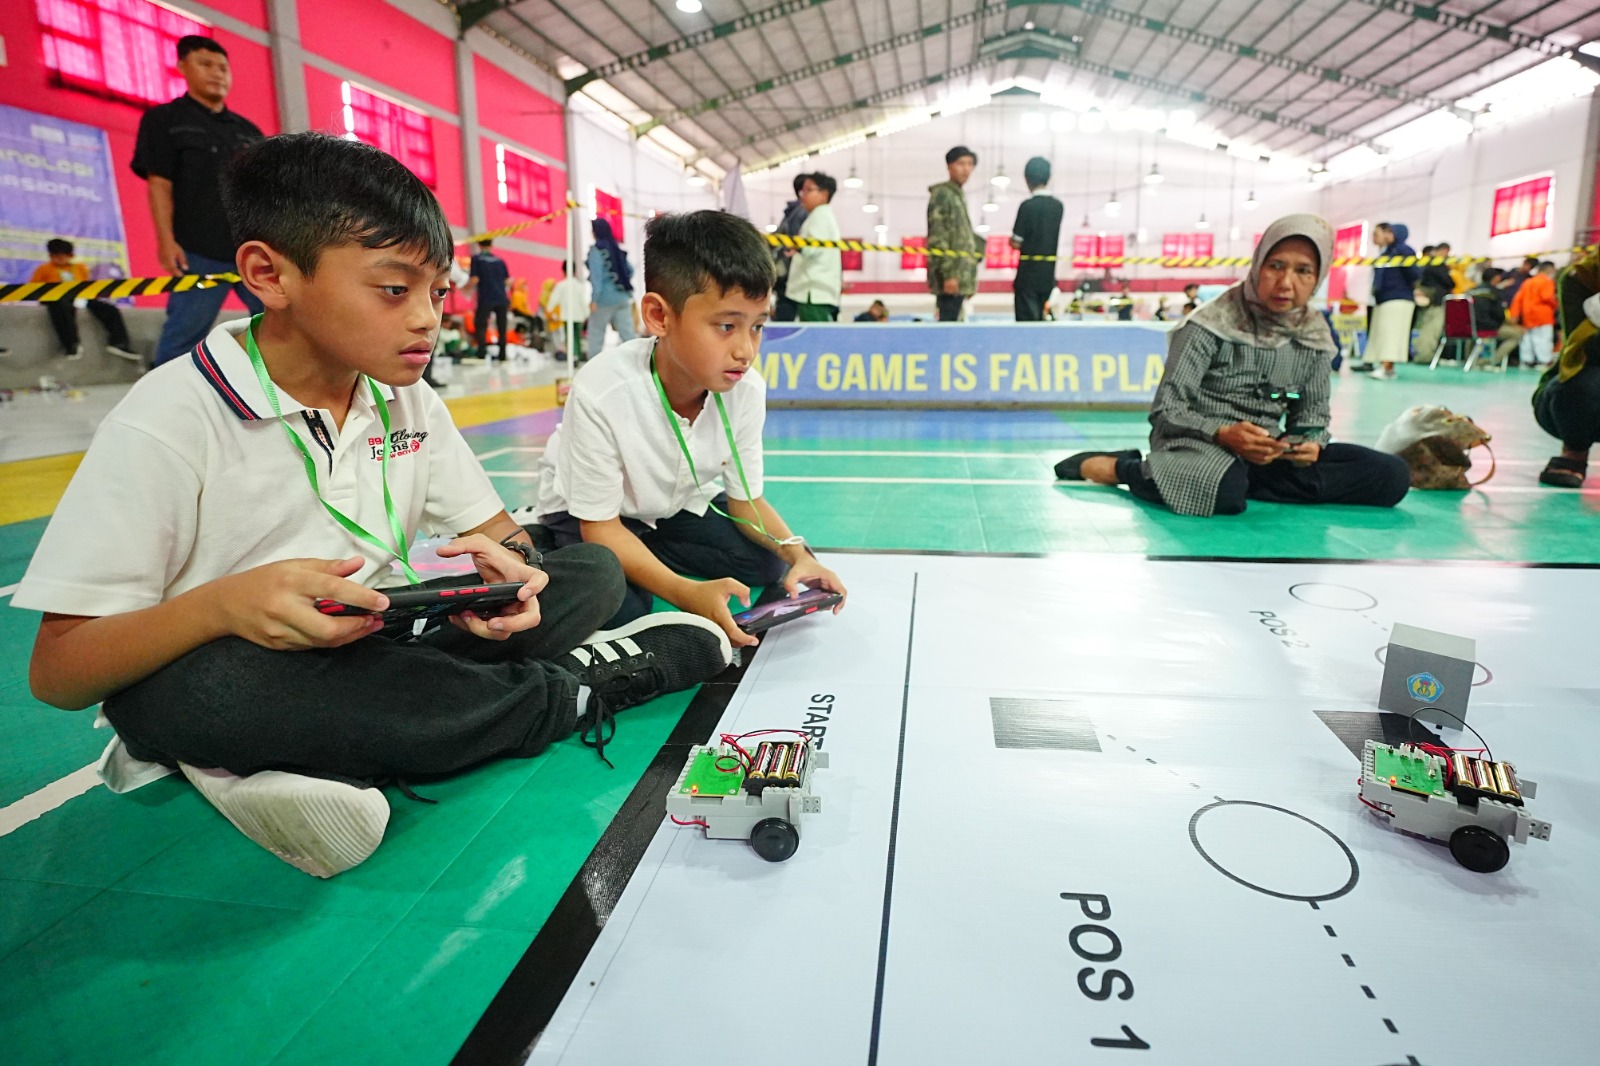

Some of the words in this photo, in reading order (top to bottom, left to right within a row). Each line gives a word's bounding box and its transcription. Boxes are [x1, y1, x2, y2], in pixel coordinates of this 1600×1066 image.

[751, 352, 807, 390] MY
[816, 352, 928, 391] GAME
[940, 353, 978, 392] IS
[989, 353, 1080, 392] FAIR
[1248, 610, 1298, 636] POS
[1280, 639, 1311, 648] 2
[801, 694, 835, 750] START
[1059, 891, 1134, 1001] POS
[1090, 1024, 1151, 1050] 1
